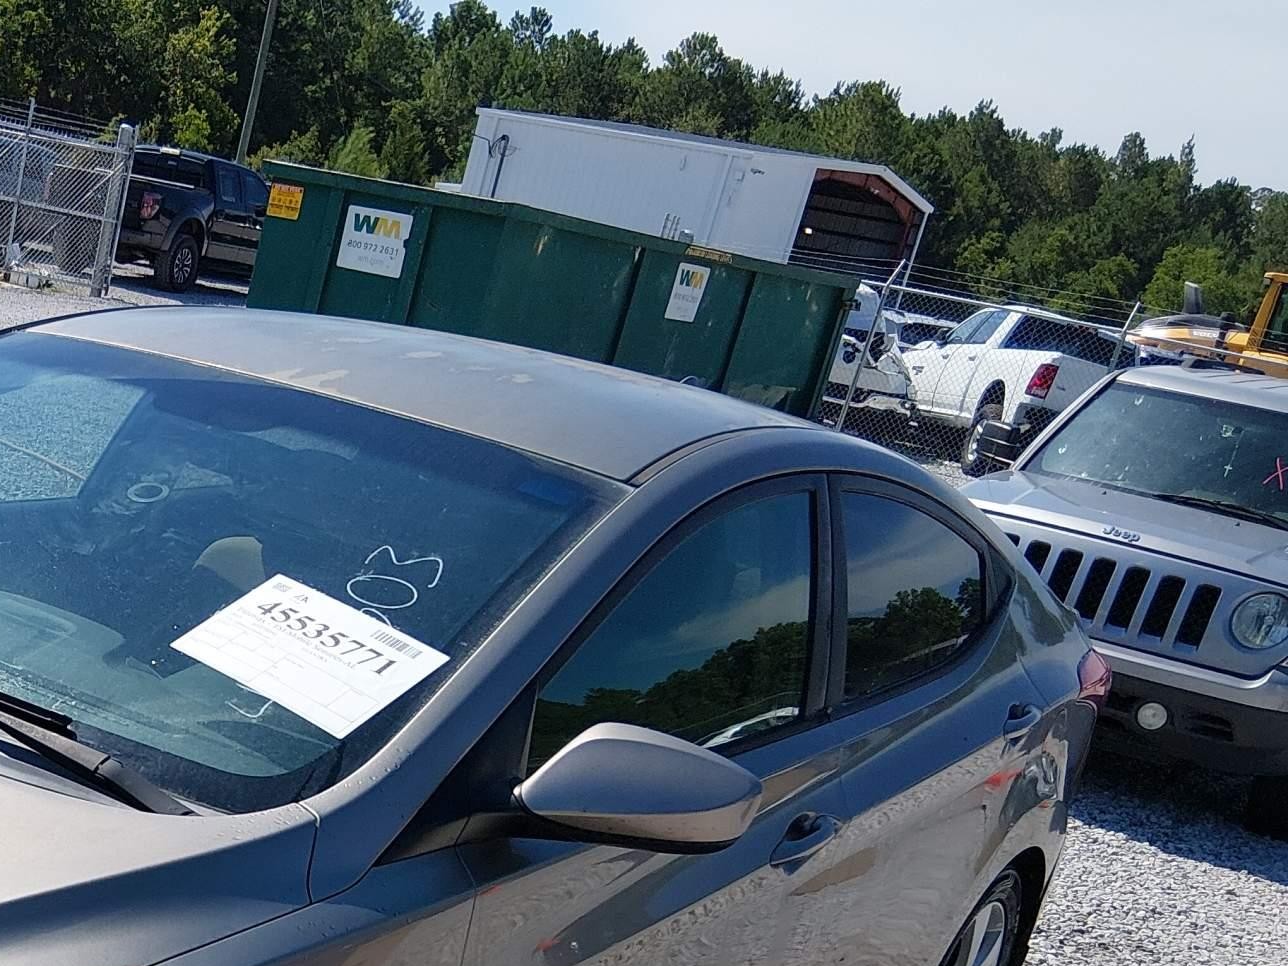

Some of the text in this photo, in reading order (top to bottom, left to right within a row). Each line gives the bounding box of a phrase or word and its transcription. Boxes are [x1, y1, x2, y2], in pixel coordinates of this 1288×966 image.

[353, 213, 401, 240] WM
[363, 243, 378, 252] 972
[379, 246, 399, 257] 2631
[679, 268, 704, 289] WM
[1102, 526, 1141, 543] Jeep
[257, 601, 397, 676] 45535771
